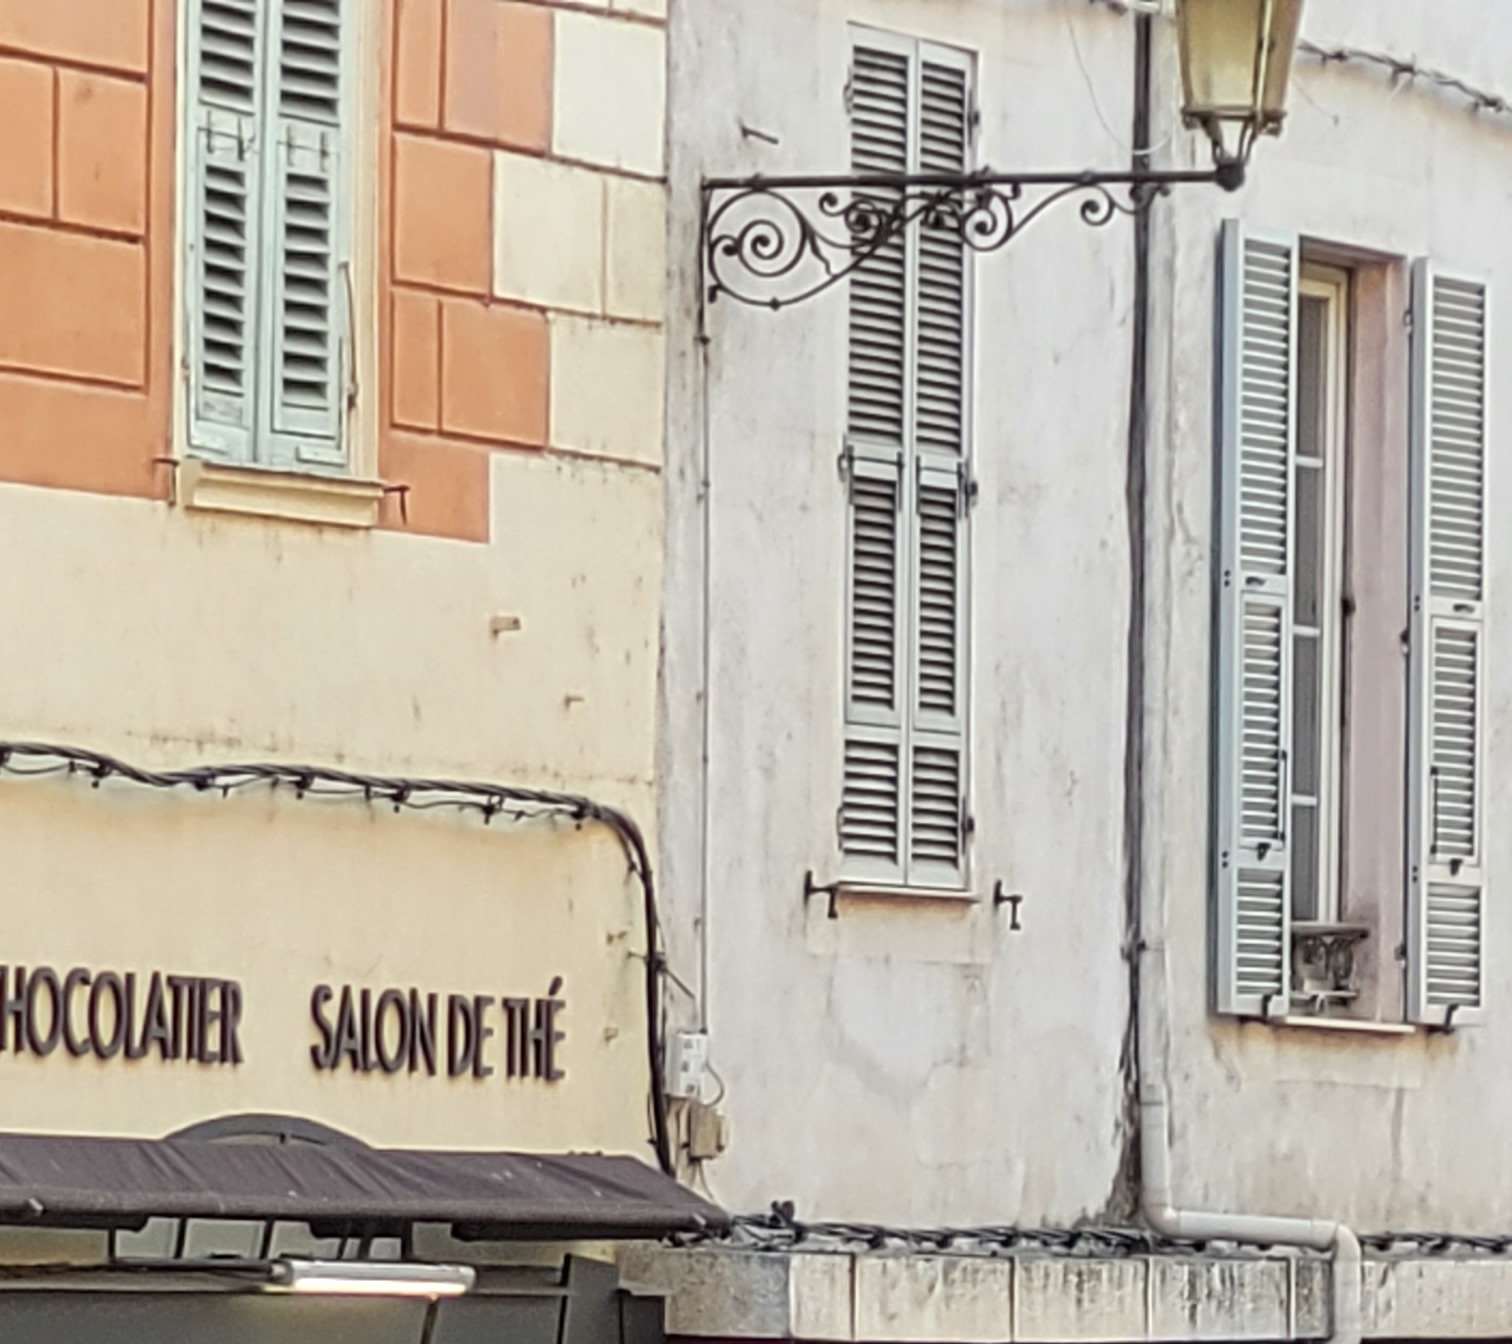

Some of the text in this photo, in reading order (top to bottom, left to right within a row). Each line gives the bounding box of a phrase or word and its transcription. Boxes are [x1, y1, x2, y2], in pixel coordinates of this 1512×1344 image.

[310, 975, 566, 1083] SALON DE THÉ
